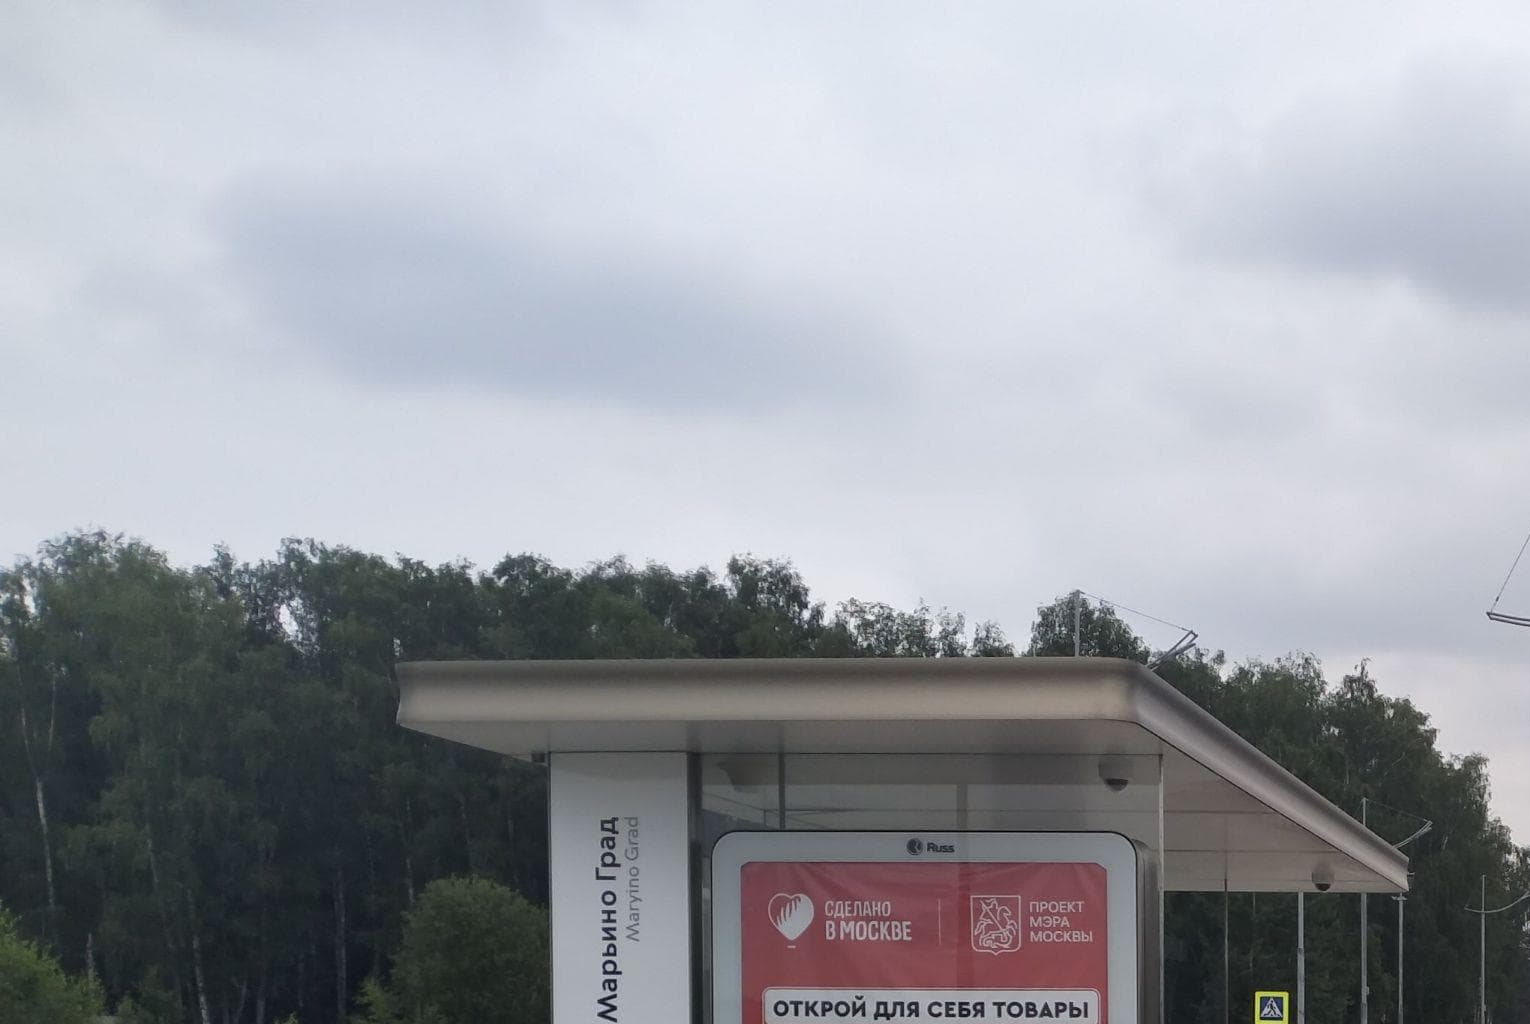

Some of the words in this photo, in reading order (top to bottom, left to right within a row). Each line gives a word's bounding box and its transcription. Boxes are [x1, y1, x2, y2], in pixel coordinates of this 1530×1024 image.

[595, 816, 621, 881] Град
[624, 816, 639, 861] Grad
[926, 842, 955, 853] Russ
[626, 866, 642, 942] Maryino
[824, 900, 891, 918] СДЕЛАНО
[1029, 901, 1085, 914] ПРОЕКТ
[825, 920, 837, 941] В
[840, 920, 912, 942] МОСКВЕ
[1029, 916, 1070, 928] МЭРА
[1029, 930, 1093, 943] МОСКВЫ
[597, 890, 622, 1023] Марьино
[773, 995, 866, 1018] ОТКРОЙ
[873, 1001, 920, 1021] ДЛЯ
[927, 1001, 985, 1018] СЕБЯ
[992, 1001, 1089, 1019] ТОВАРЫ
